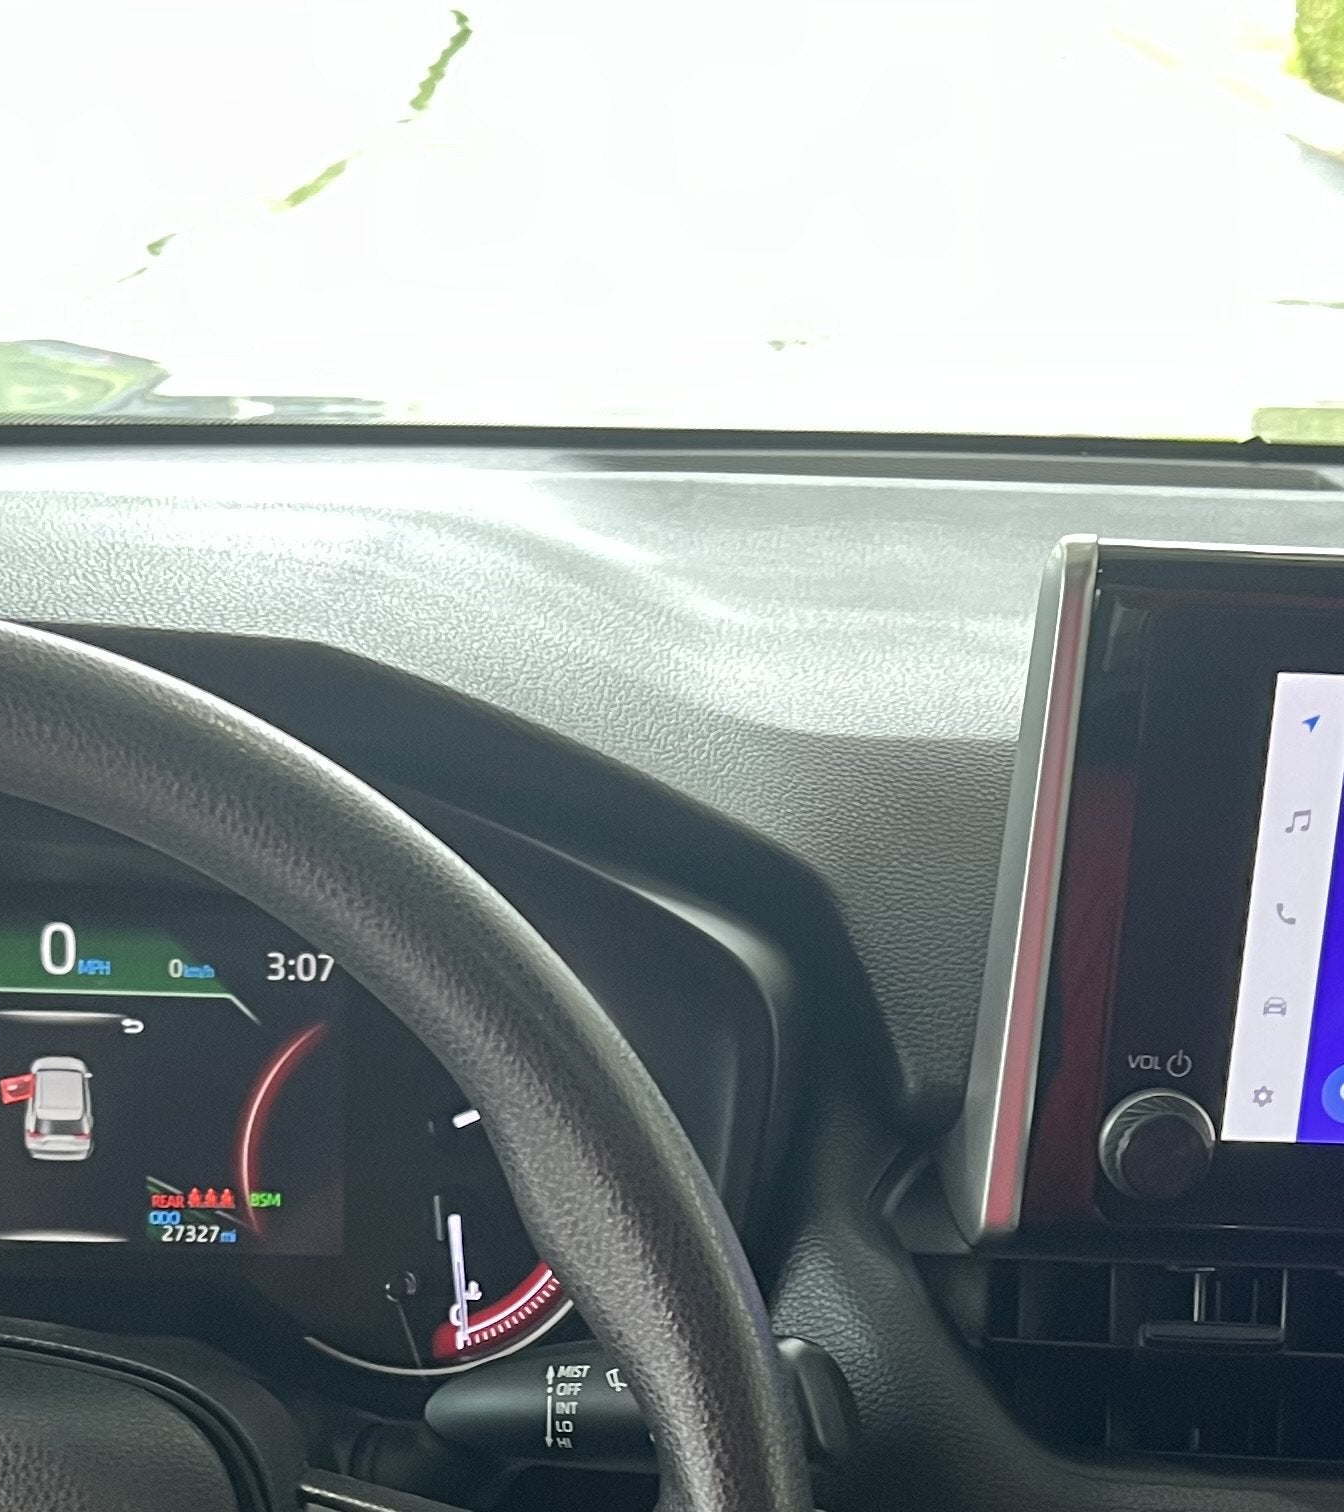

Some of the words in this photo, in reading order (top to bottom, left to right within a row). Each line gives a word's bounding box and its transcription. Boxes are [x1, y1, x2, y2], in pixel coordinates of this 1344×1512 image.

[40, 922, 76, 975] 0
[78, 959, 111, 975] MPH
[168, 958, 183, 978] 0
[266, 952, 336, 982] 3:07
[1128, 1054, 1161, 1070] VOL
[152, 1194, 185, 1208] REAR
[250, 1193, 281, 1207] BSM
[161, 1225, 220, 1242] 27327
[557, 1365, 591, 1378] MIST
[556, 1383, 583, 1396] OFF
[556, 1402, 579, 1415] INT
[556, 1421, 573, 1433] LO
